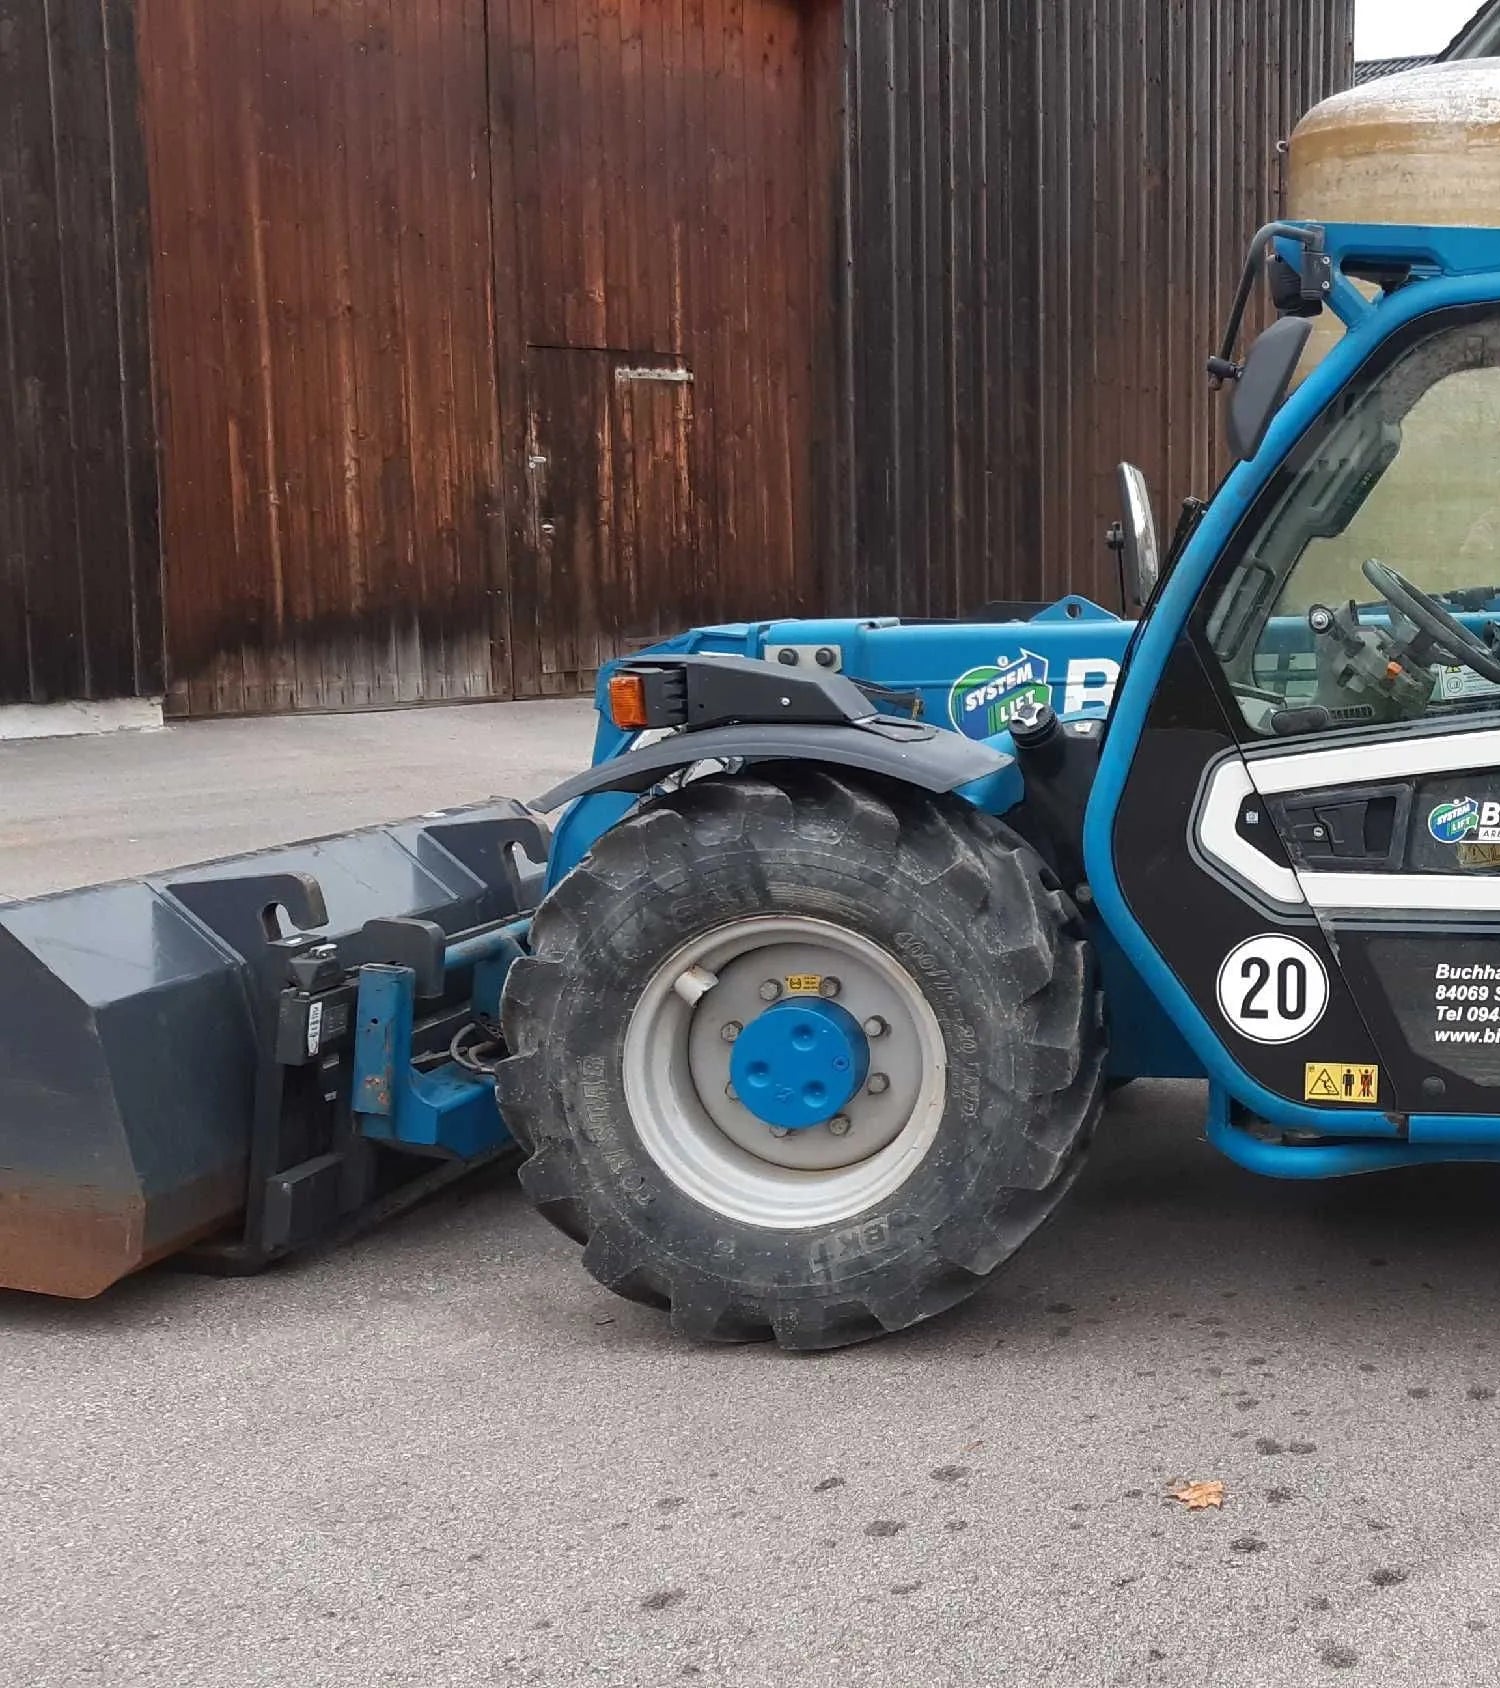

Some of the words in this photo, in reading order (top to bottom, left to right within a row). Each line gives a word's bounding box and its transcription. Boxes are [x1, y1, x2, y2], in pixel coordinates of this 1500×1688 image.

[965, 662, 1033, 712] SYSTEM
[1000, 689, 1036, 723] LIFT
[1437, 802, 1471, 825] SYSTEM
[1453, 816, 1471, 831] LIFT
[1240, 956, 1307, 1020] 20
[1435, 984, 1489, 1001] 84069
[1435, 1005, 1463, 1022] Tel
